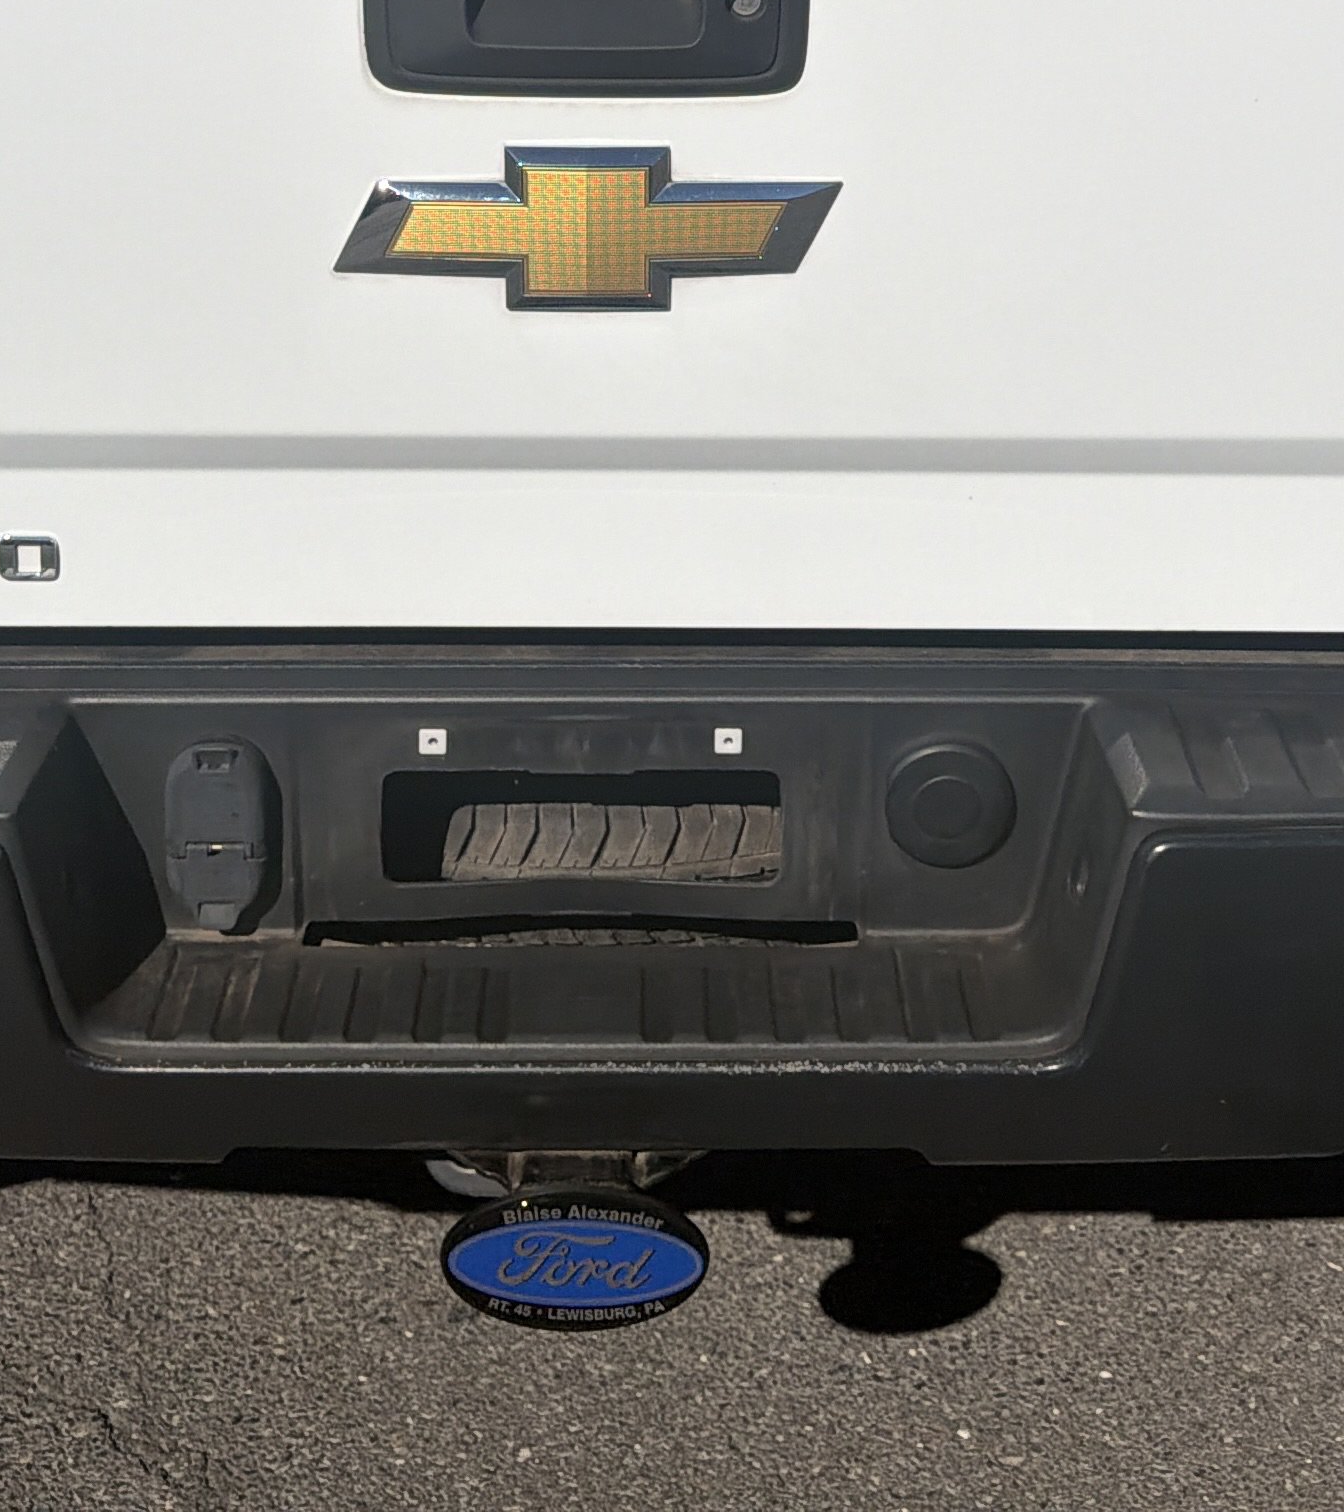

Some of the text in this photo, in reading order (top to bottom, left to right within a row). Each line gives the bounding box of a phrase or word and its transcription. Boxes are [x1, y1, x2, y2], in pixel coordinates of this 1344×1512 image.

[503, 1204, 665, 1230] Blaise Alexander
[496, 1231, 656, 1289] Ford
[487, 1297, 666, 1322] RT. 45 LEWISBURG, PA
